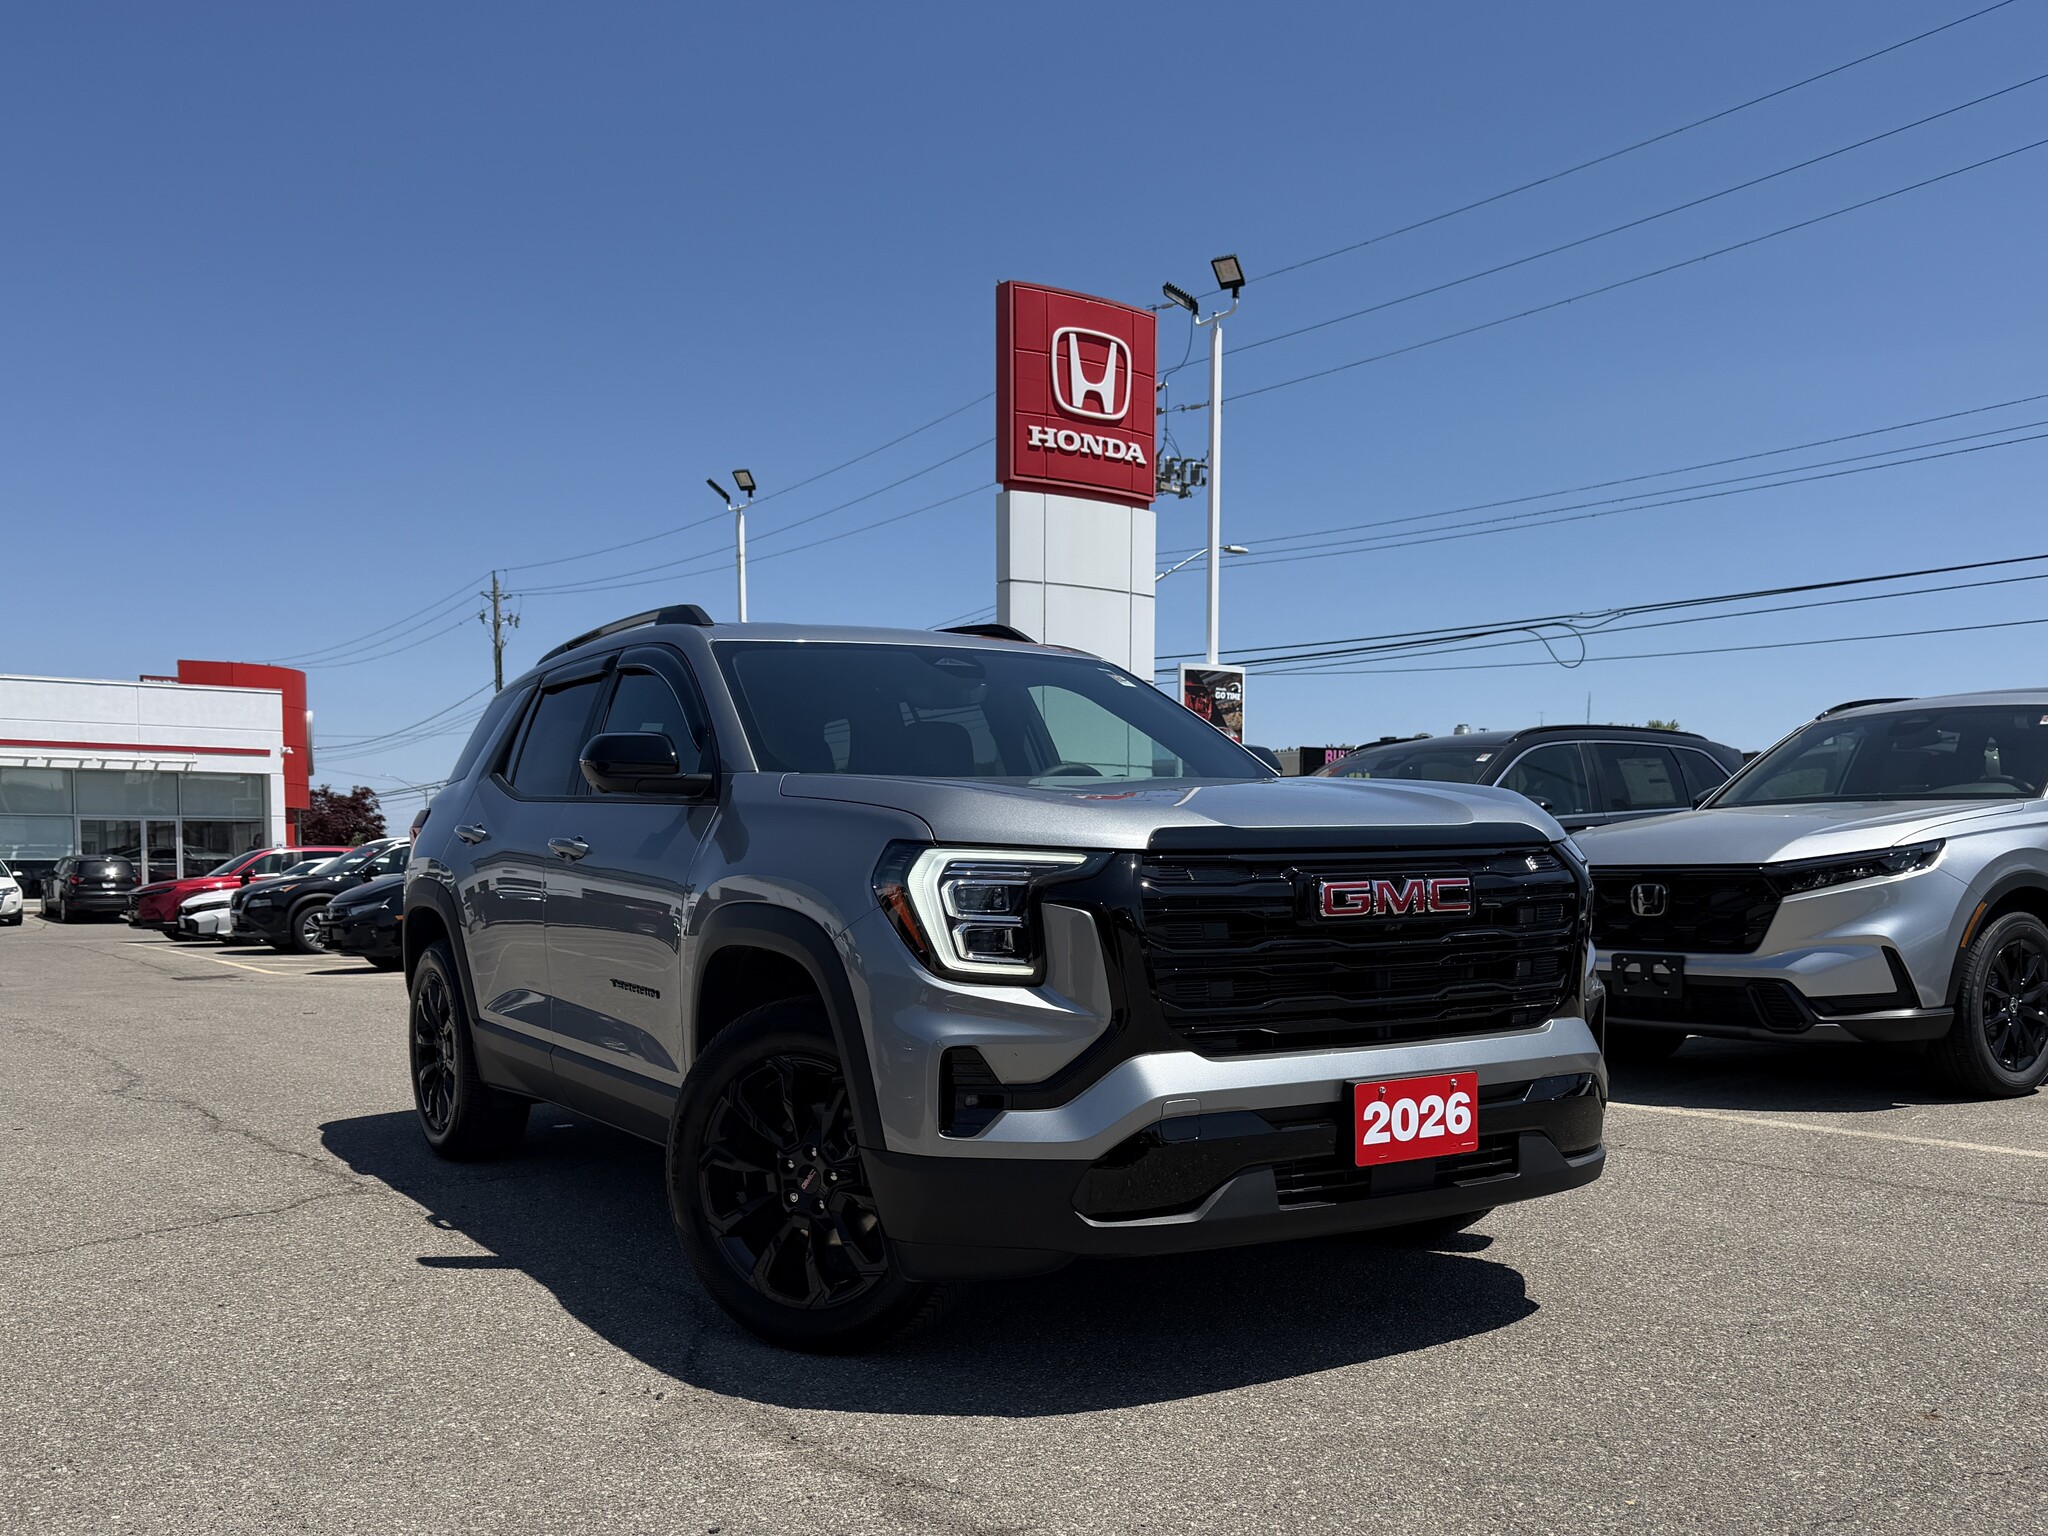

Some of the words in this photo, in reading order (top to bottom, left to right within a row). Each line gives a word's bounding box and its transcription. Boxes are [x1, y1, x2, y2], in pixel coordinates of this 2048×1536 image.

[1028, 425, 1147, 464] HONDA
[1215, 691, 1226, 699] GO
[1319, 877, 1471, 917] GMC
[1363, 1091, 1472, 1145] 2026
